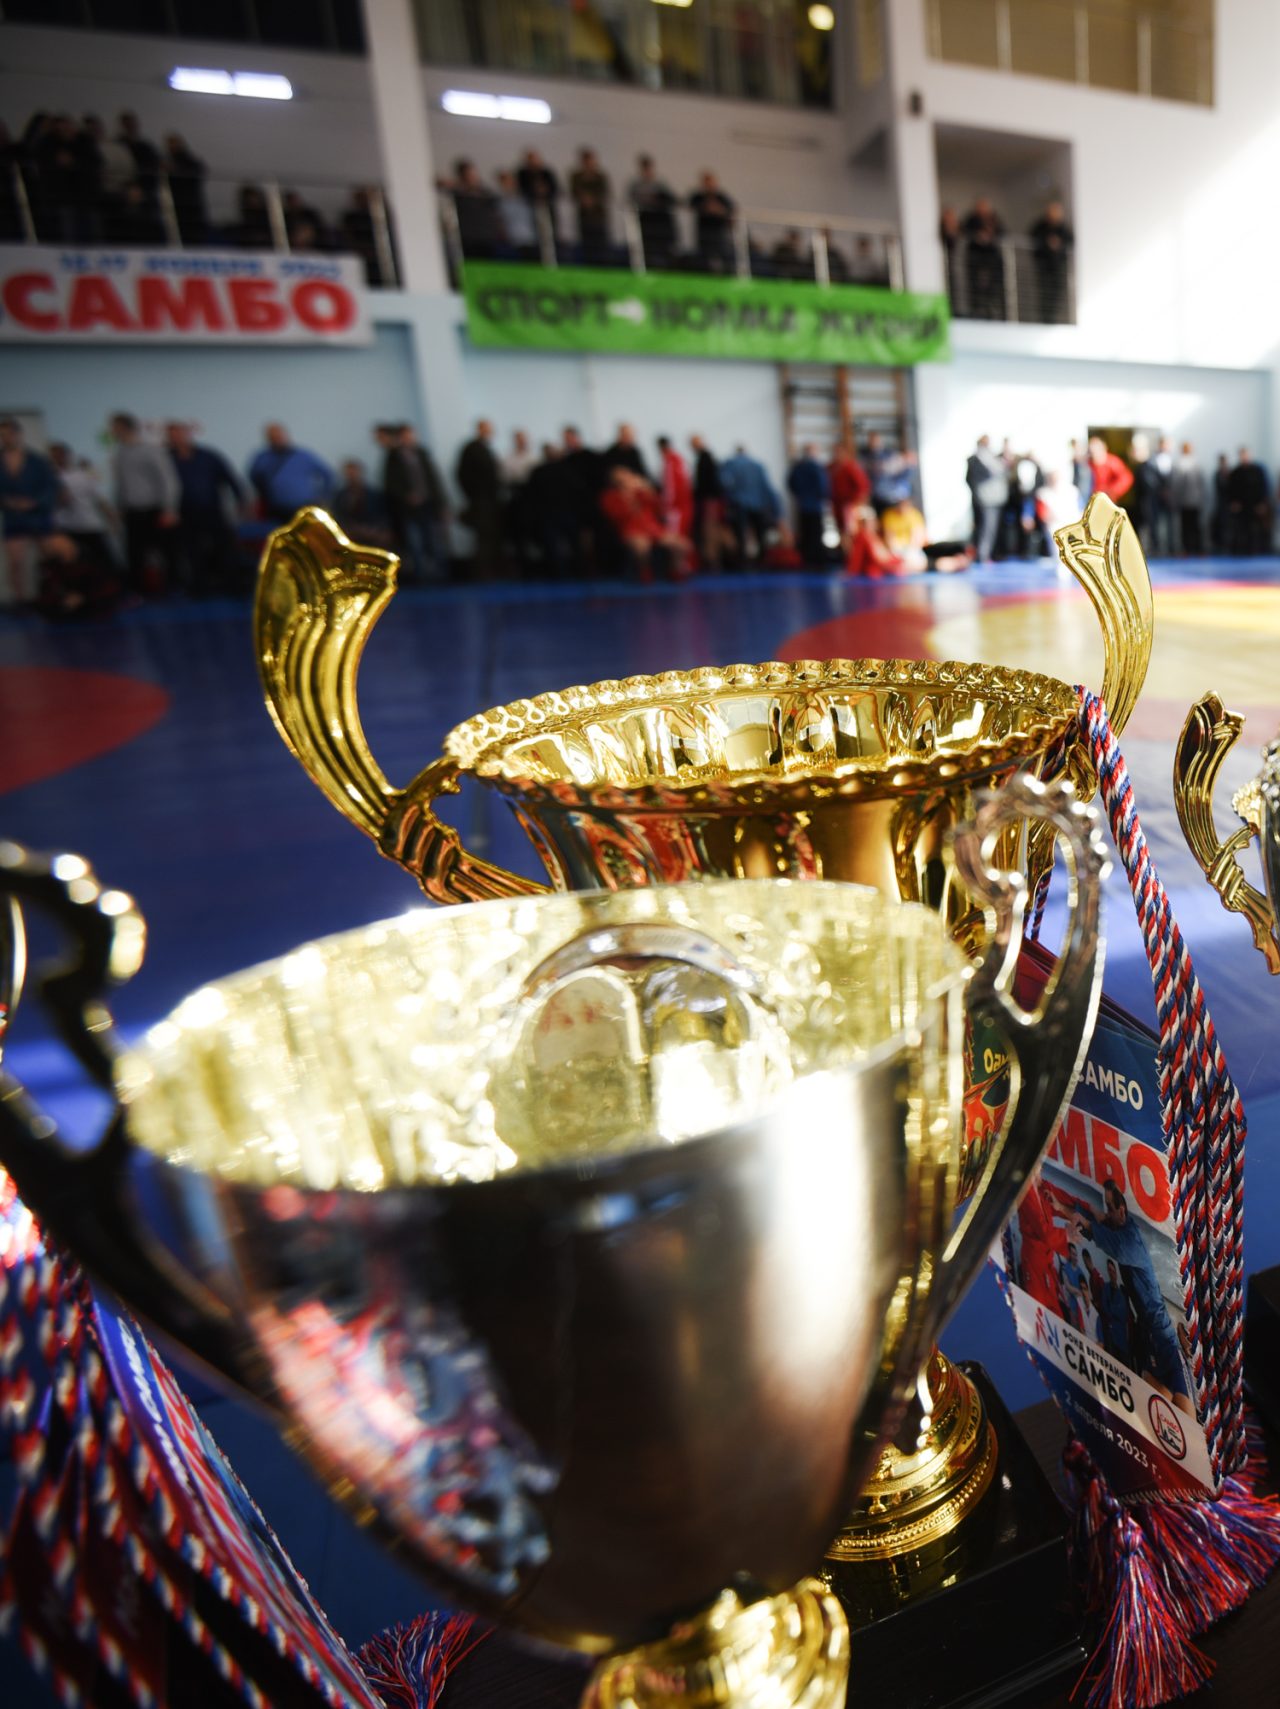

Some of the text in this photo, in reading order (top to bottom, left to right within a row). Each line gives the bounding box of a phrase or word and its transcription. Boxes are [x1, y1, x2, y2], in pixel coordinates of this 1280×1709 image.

[1, 270, 357, 335] САМБО
[478, 283, 614, 331] СПОРТ
[1078, 1060, 1144, 1111] АМБО
[1062, 1328, 1132, 1387] ФОНД ВЕТЕРАНОВ
[1064, 1344, 1135, 1413] САМБО
[1116, 1433, 1149, 1469] 2023
[1152, 1463, 1163, 1480] г.
